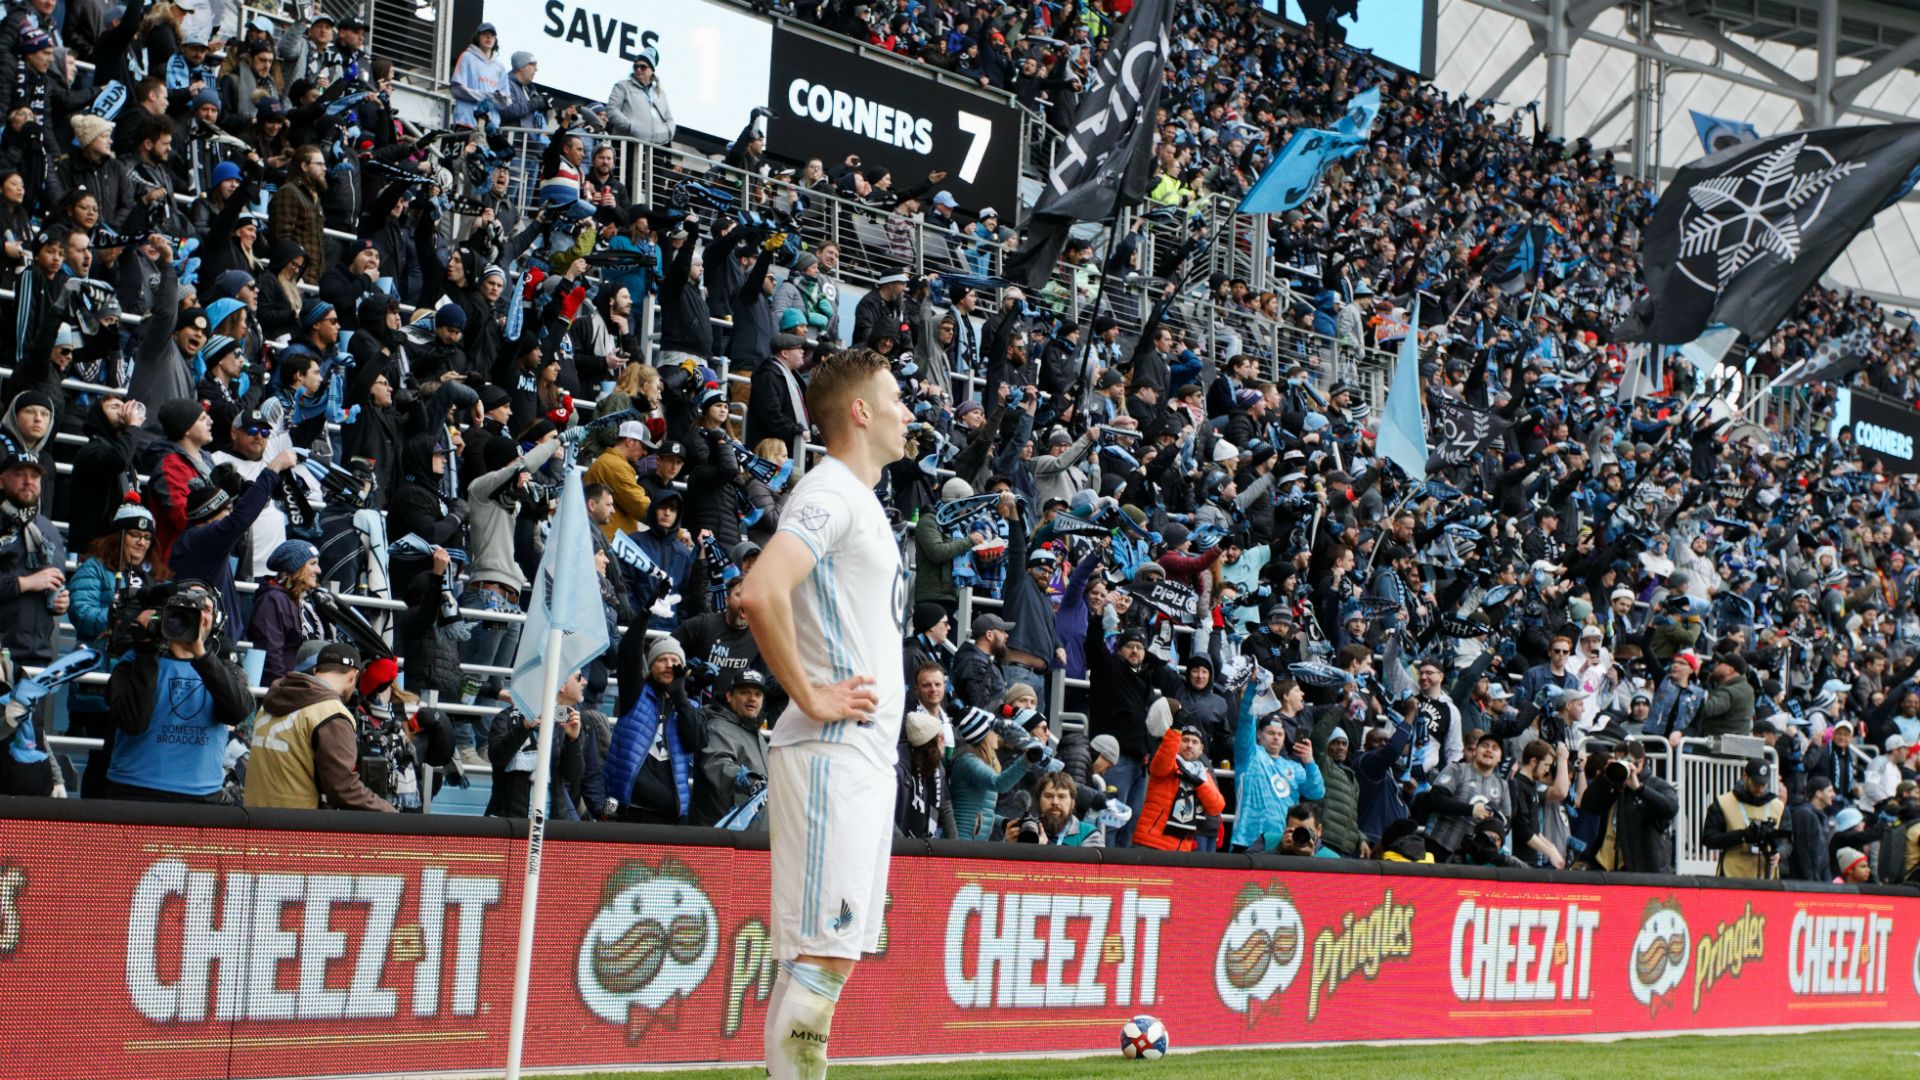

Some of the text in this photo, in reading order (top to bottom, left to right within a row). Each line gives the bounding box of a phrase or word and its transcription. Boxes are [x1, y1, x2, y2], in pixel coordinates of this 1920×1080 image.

[544, 0, 660, 65] SAVES
[788, 77, 992, 185] CORNERS 7
[1855, 420, 1914, 461] CORNERS
[1151, 584, 1186, 607] Field
[711, 643, 730, 657] MN
[708, 654, 749, 669] UNITED
[171, 680, 192, 690] MLS
[161, 724, 208, 736] DOMESTIC
[156, 734, 210, 746] BROADCAST
[1307, 888, 1415, 1022] Pringles
[1693, 901, 1767, 1014] Pringles
[790, 1028, 830, 1044] MNU
